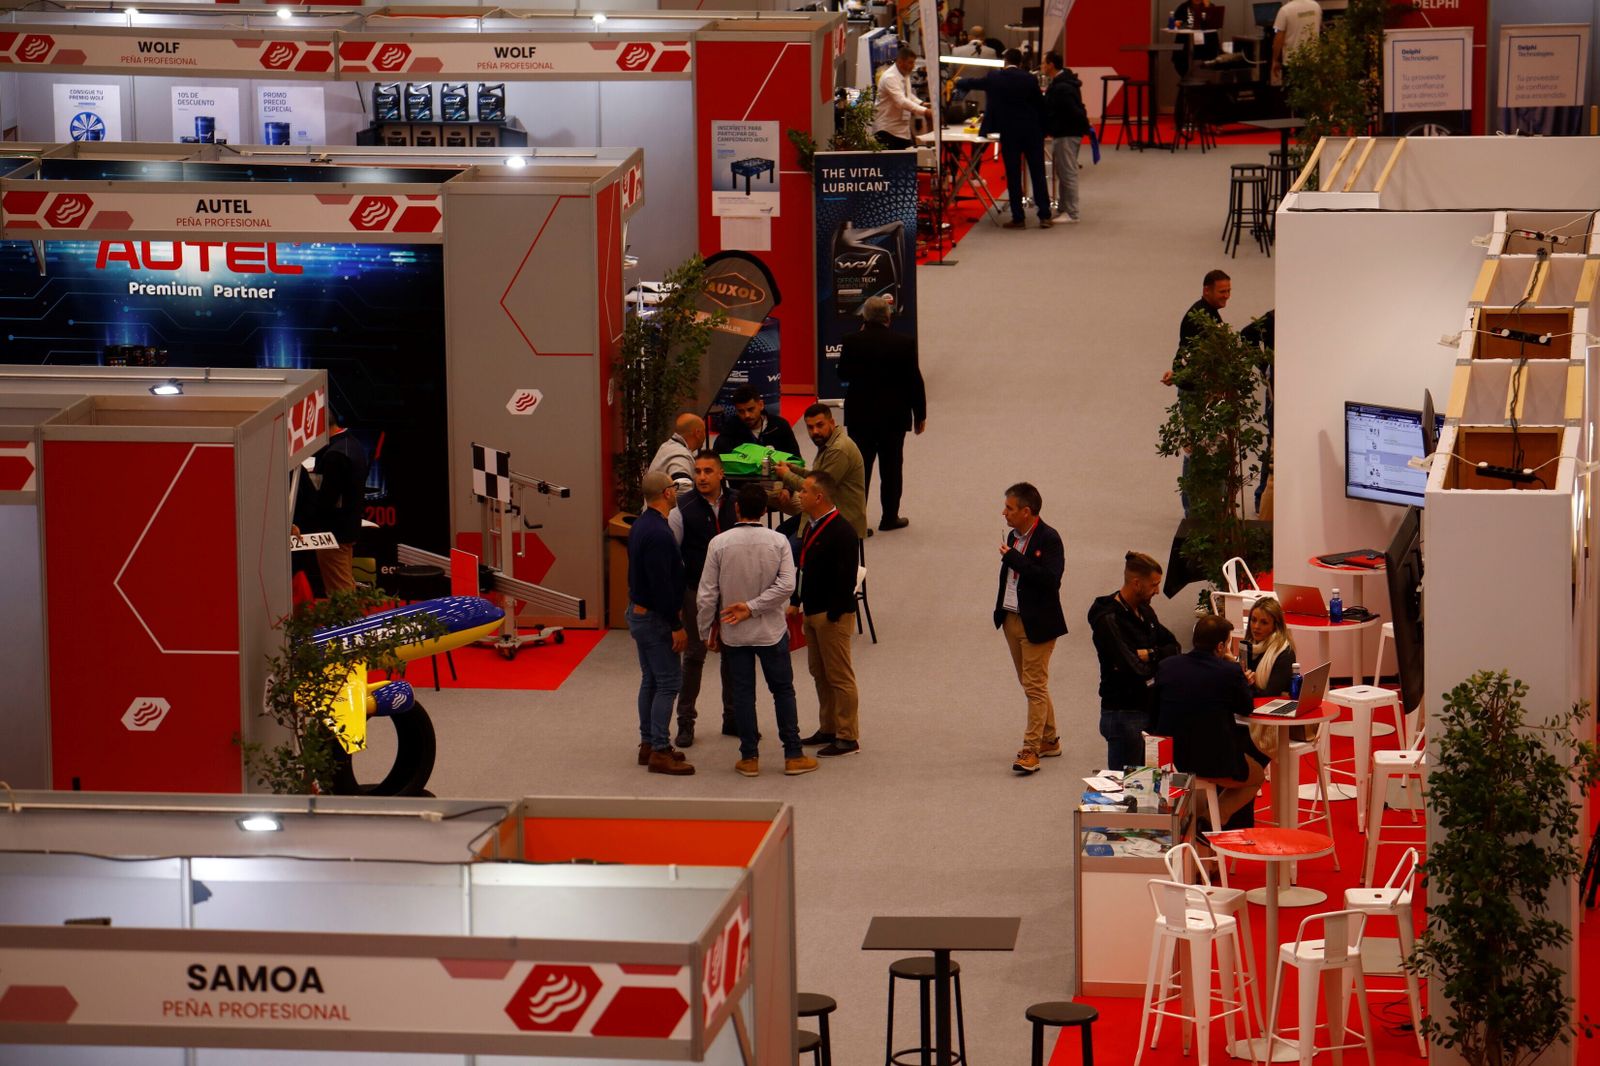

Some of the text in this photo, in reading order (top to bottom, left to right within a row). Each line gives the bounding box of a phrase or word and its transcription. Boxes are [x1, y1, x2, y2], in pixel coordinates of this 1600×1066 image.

[1413, 0, 1460, 9] DELPHI
[137, 41, 180, 54] WOLF
[494, 46, 537, 59] WOLF
[121, 55, 198, 66] PEÑA PROFESIONAL
[477, 60, 555, 70] PEÑA PROFESIONAL
[822, 167, 883, 179] THE VITAL
[822, 181, 890, 193] LUBRICANT
[195, 199, 252, 214] AUTEL
[176, 217, 272, 228] PEÑA PROFESIONAL
[96, 240, 304, 275] AUTEL
[129, 281, 276, 299] Premium Partner
[706, 282, 757, 300] AUXOL
[310, 535, 334, 546] SAM
[187, 963, 325, 994] SAMOA
[163, 999, 351, 1021] PEÑA PROFESIONAL
